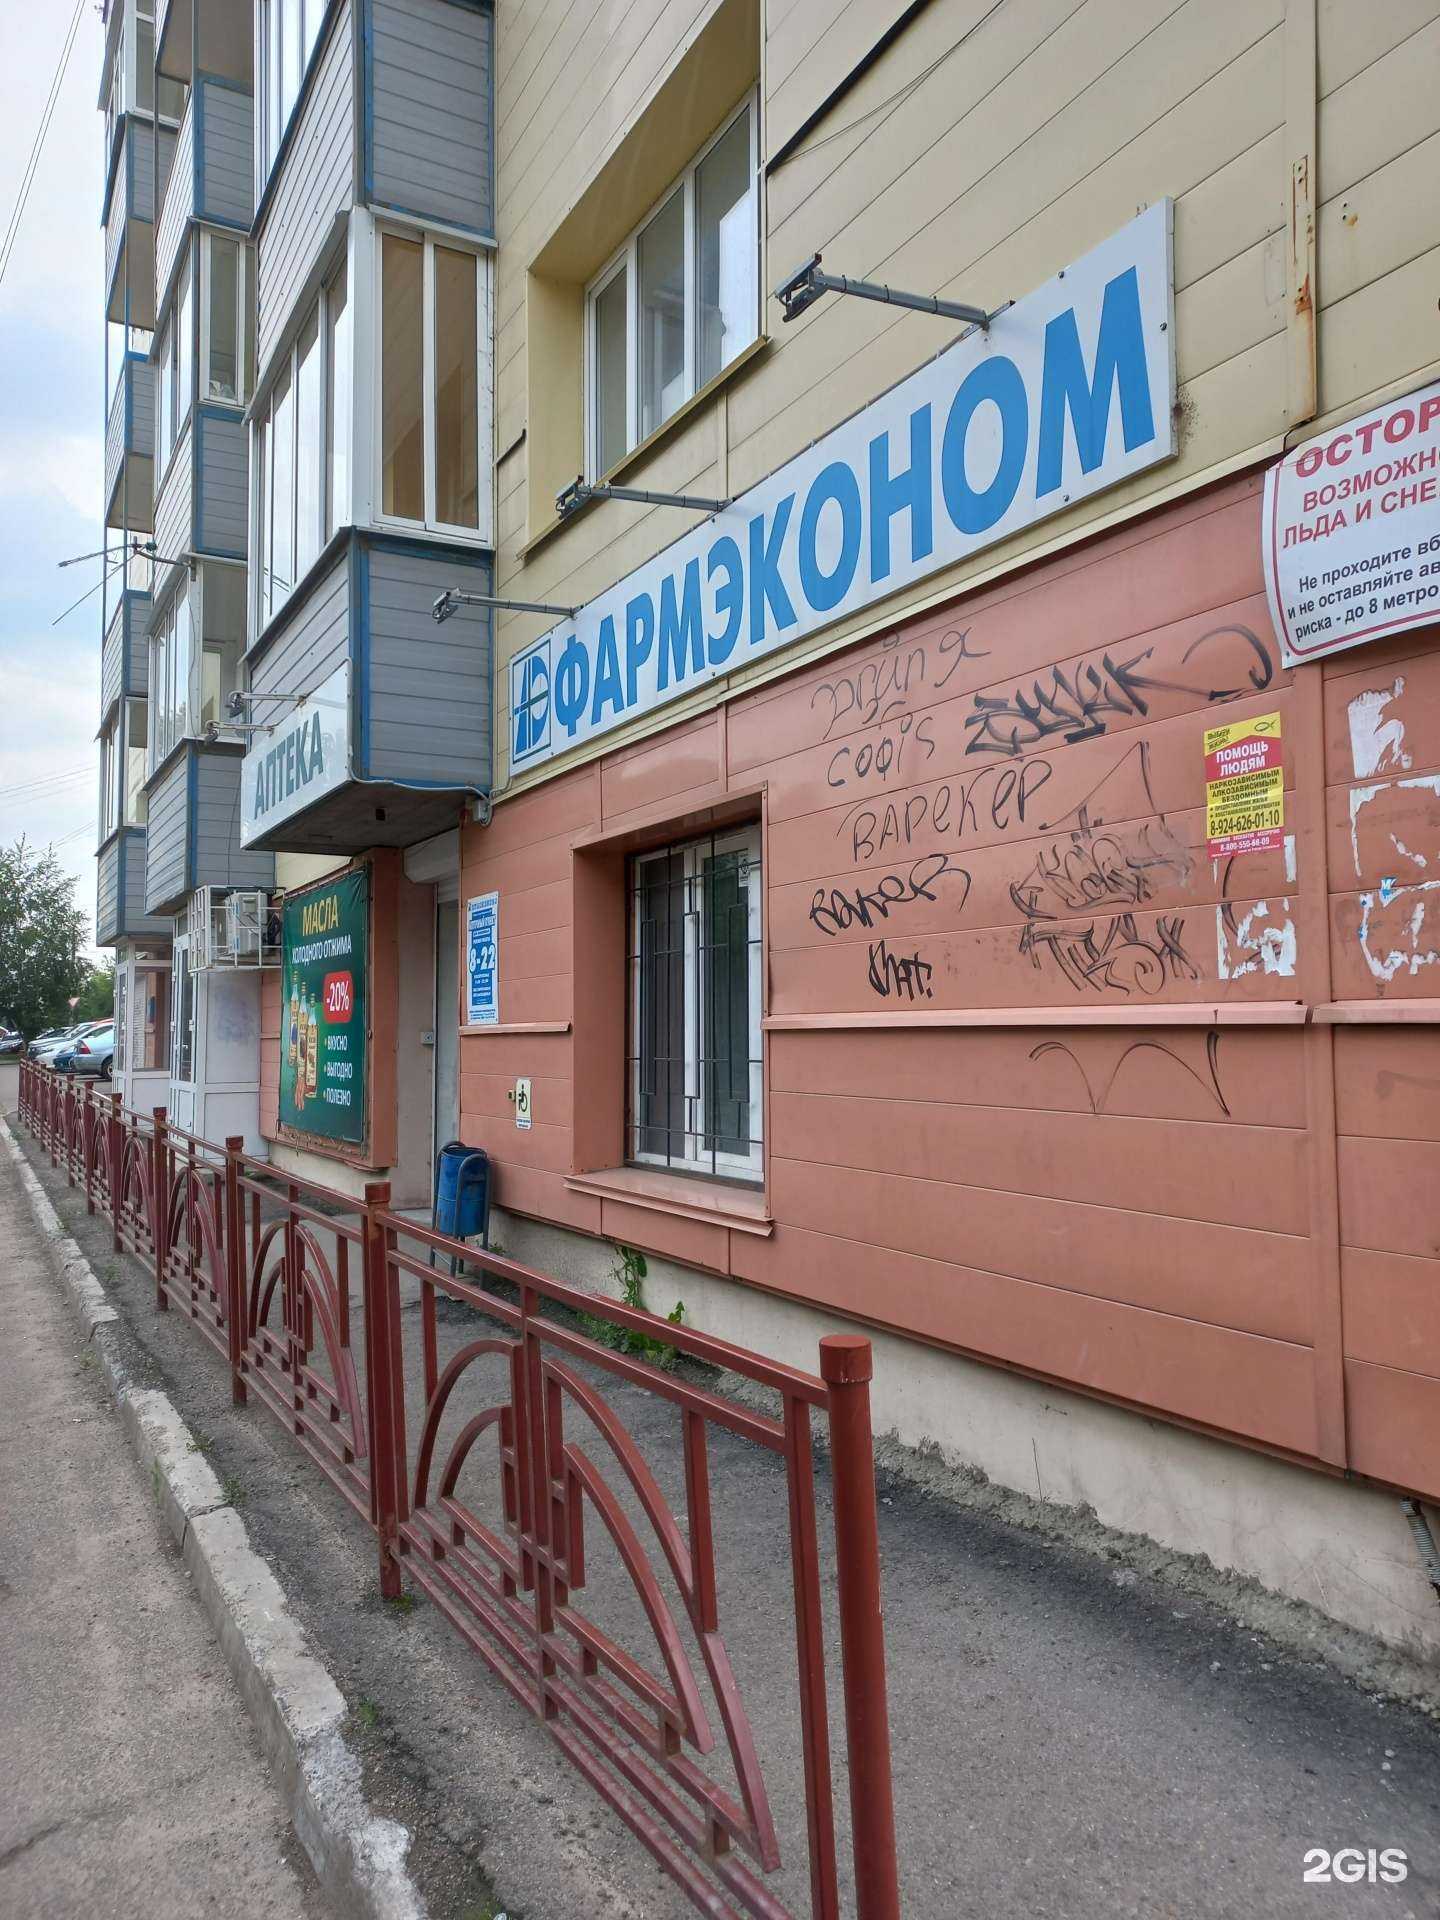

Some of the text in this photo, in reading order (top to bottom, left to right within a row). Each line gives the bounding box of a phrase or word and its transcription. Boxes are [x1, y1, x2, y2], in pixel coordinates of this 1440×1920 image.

[1303, 446, 1440, 513] ВОЗМОЖН
[555, 265, 1155, 737] ФАРМЭКОНОМ
[1283, 477, 1440, 549] ЛЬДА И СНЕ
[1299, 576, 1318, 593] Не
[1322, 547, 1412, 585] проходите
[1287, 607, 1296, 620] и
[1299, 600, 1315, 616] не
[1318, 568, 1413, 608] оставляйте
[1295, 616, 1332, 642] риска
[1345, 606, 1364, 624] до
[1369, 598, 1378, 614] 8
[1383, 585, 1440, 611] метро
[254, 710, 324, 820] АПТЕКА
[1216, 741, 1269, 763] ПОМОЩЬ
[1220, 756, 1266, 777] ЛЮДЯМ
[1209, 769, 1280, 791] НАРКОЗАВИСИМЫМ
[1212, 778, 1278, 798] АЛКОЗАВИСИМЫМ
[1222, 788, 1269, 803] БЕЗДОМНЫМ
[1210, 809, 1280, 836] 8-924-626-01-10
[303, 895, 338, 937] МАСЛА
[292, 934, 352, 967] ХОЛОДНОГО ОТЖИМА
[469, 944, 496, 973] 8-22
[326, 980, 350, 1012] -20%
[327, 1035, 348, 1051] ВКУСНО
[326, 1062, 353, 1081] ВЫГОДНО
[326, 1087, 351, 1107] ПОЛЕЗНО
